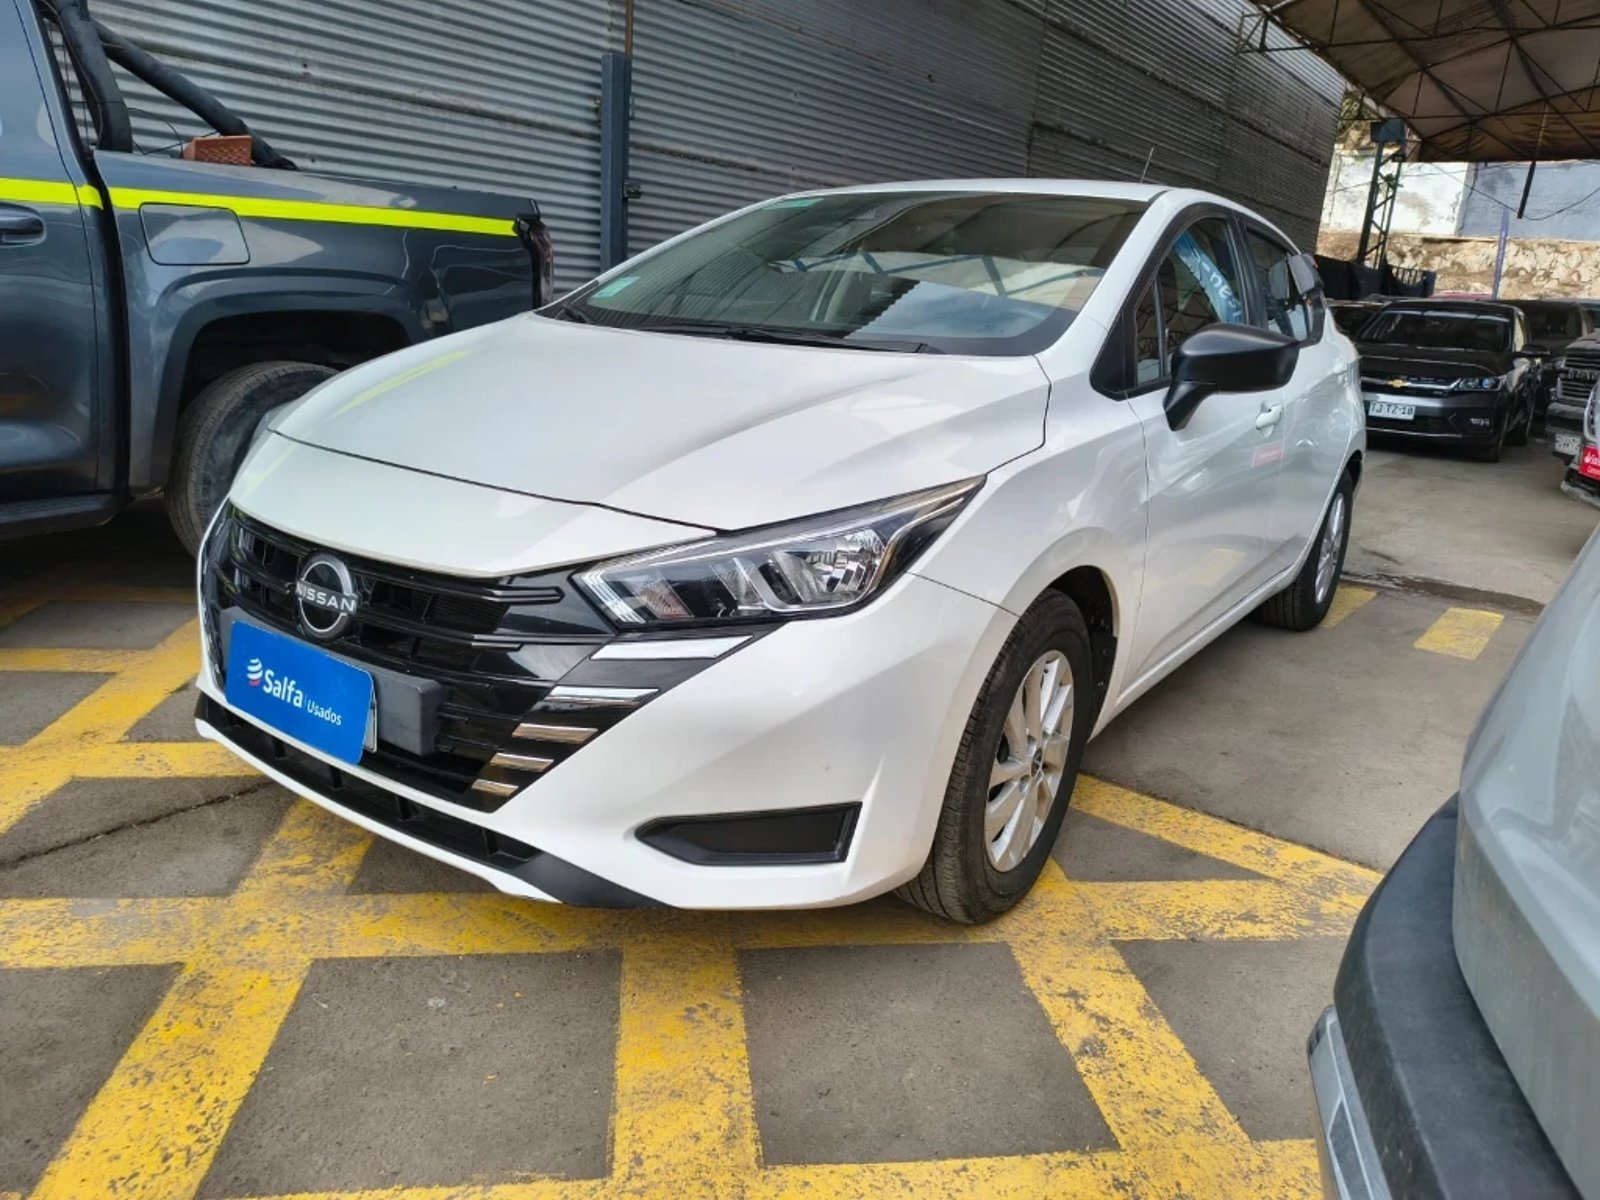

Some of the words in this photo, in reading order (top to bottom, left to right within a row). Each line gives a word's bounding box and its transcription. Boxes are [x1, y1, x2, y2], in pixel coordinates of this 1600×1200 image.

[297, 580, 356, 612] NISSAN
[262, 668, 304, 708] Salfa
[307, 698, 342, 726] Usados
